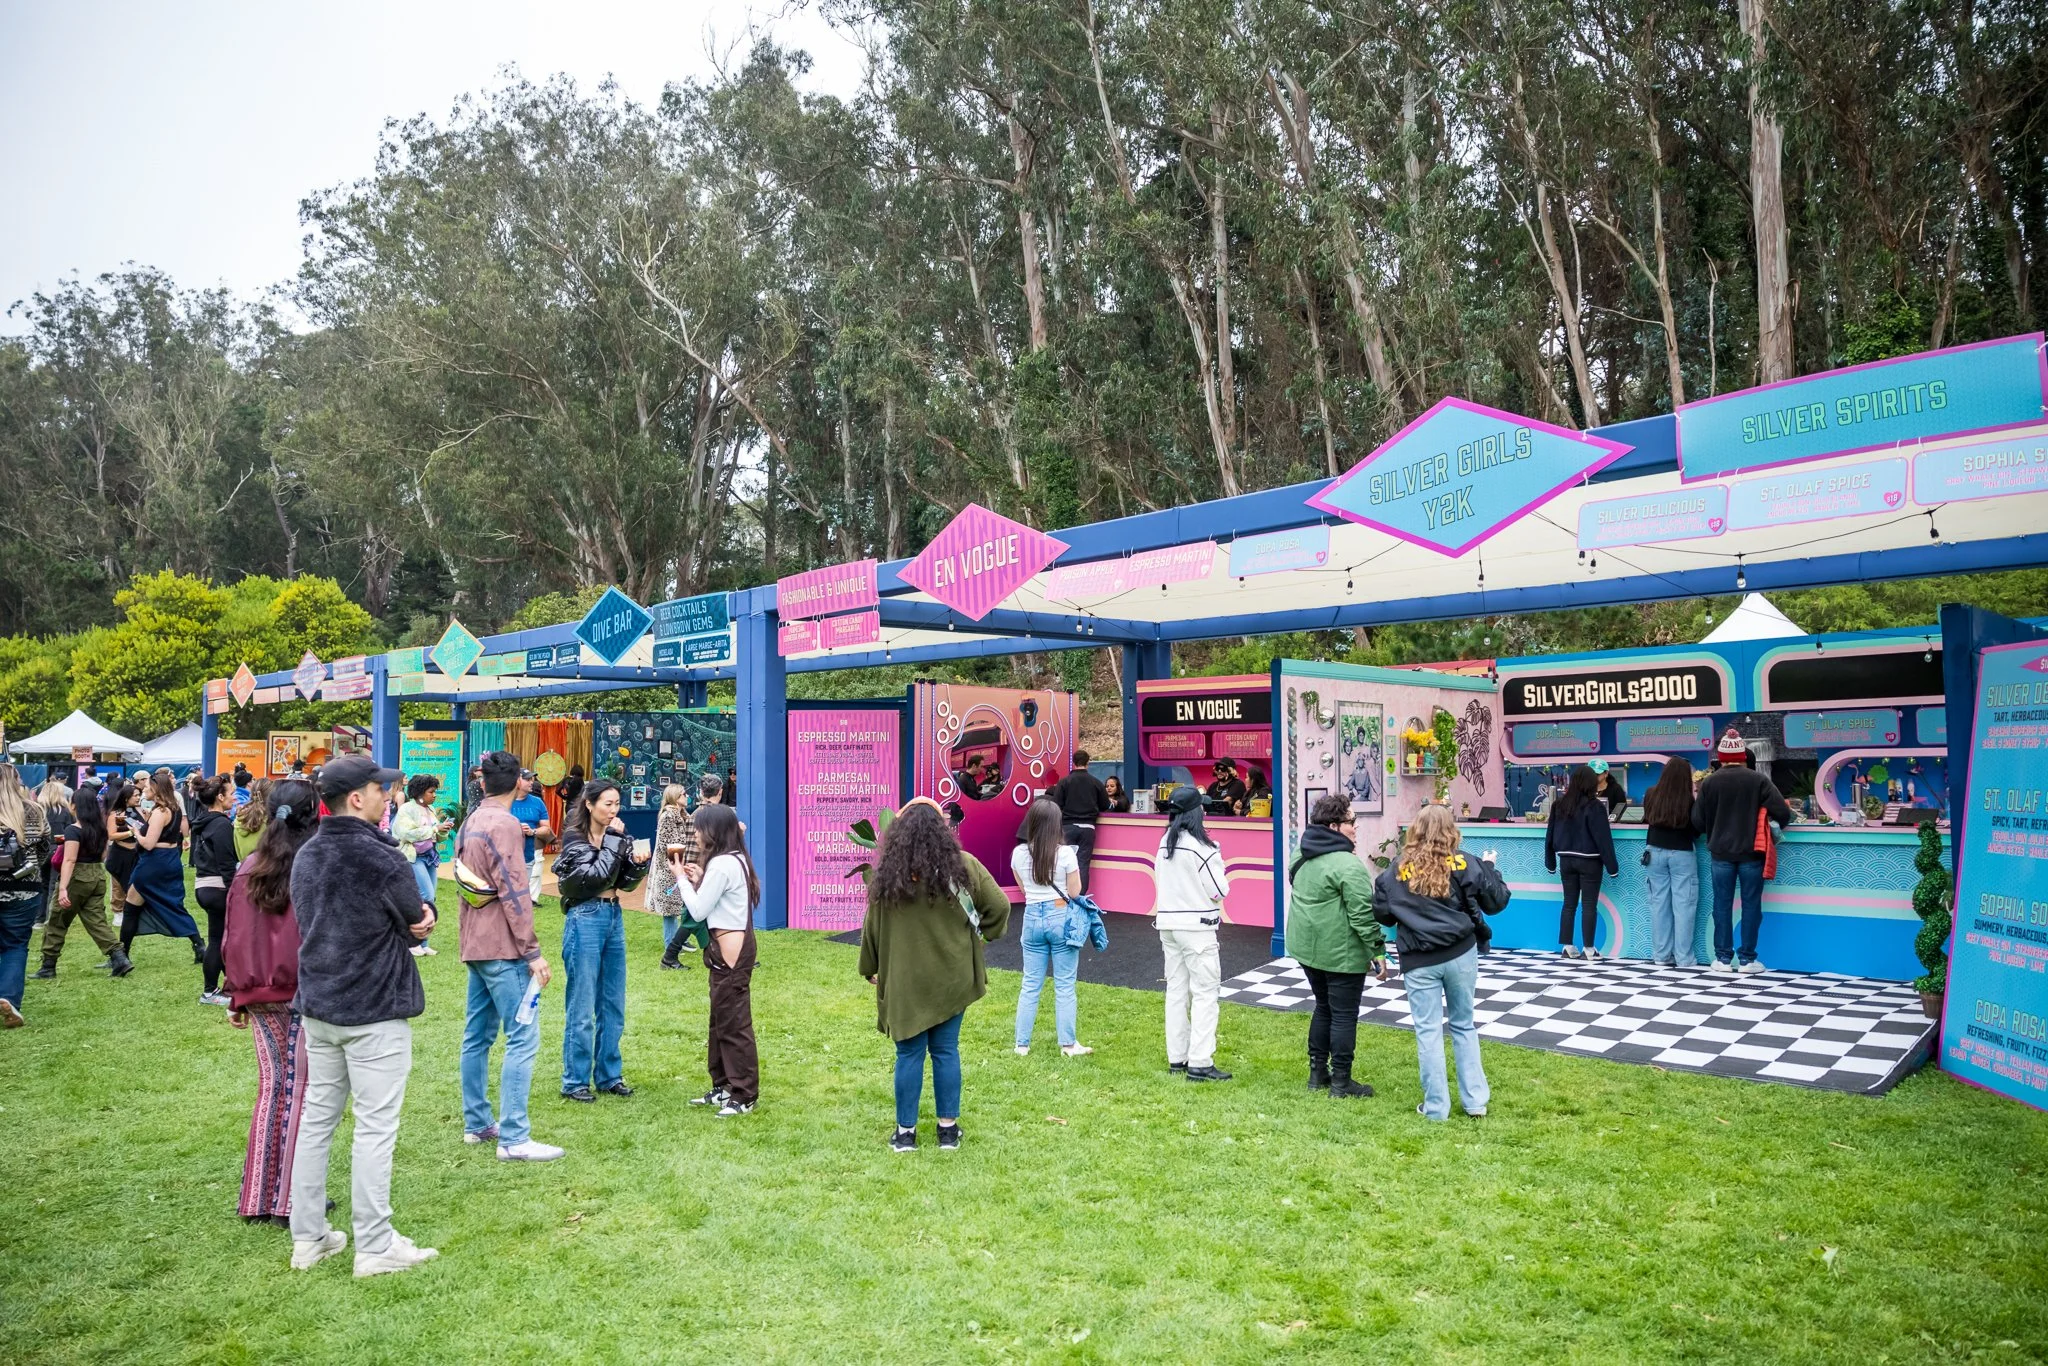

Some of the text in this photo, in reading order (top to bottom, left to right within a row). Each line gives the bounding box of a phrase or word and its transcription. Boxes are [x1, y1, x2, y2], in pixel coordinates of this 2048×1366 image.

[1742, 379, 1947, 444] SILVER SPIRITS
[1369, 427, 1532, 506] SILVER GIRLS
[1963, 450, 2028, 472] SOPHIA
[1760, 473, 1871, 502] ST. OLAF SPICE
[1422, 485, 1475, 531] Y2K
[1598, 498, 1706, 525] SILVER DELICIOUS
[934, 533, 1020, 589] EN VOGUE
[1060, 563, 1115, 580] POISON APPLE
[1129, 555, 1172, 573] ESPRESSO
[1173, 549, 1212, 565] MARTINI
[782, 576, 867, 606] FASHIONABLE & UNIQUE
[660, 600, 707, 620] BEER COCKTAILS
[592, 609, 632, 643] DIVE BAR
[663, 620, 691, 636] LOWBROW
[692, 616, 713, 631] GEMS
[685, 643, 698, 652] LARGE
[1987, 683, 2030, 708] SILVER
[1176, 698, 1242, 721] EN VOGUE
[1994, 711, 2010, 723] TART,
[1848, 718, 1876, 729] SPICE
[798, 731, 890, 742] ESPRESSO MARTINI
[1721, 740, 1745, 749] GIANT
[818, 772, 870, 783] PARMESAN
[798, 784, 890, 795] ESPRESSO MARTINI
[1984, 788, 2041, 813] ST. OLAF
[1992, 815, 2048, 831] SPICY, TART, REFR
[808, 831, 845, 842] COTTON
[817, 843, 872, 854] MARGARITA
[810, 884, 867, 895] POISON APP
[1980, 892, 2025, 922] SOPHIA
[1974, 919, 2005, 936] SUMMERY,
[1975, 999, 2047, 1044] COPA ROSA
[1967, 1024, 2005, 1048] REFRESHING,
[2006, 1038, 2031, 1058] FRUITY,
